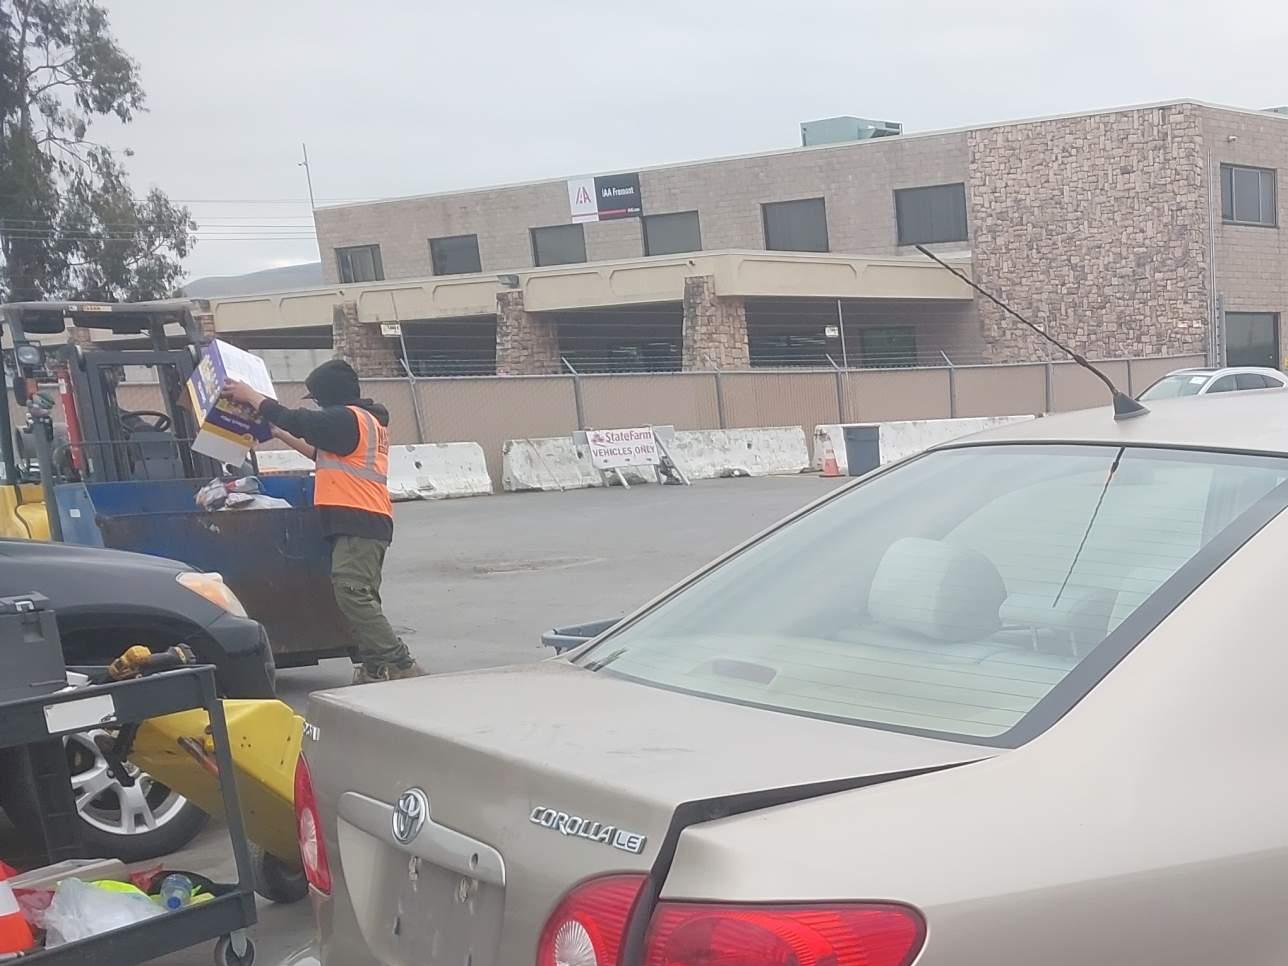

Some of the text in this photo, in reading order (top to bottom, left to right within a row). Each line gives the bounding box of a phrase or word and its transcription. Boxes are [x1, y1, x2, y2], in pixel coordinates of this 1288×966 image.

[602, 187, 613, 198] IAA
[592, 445, 656, 457] VEHICLES ONLY
[529, 806, 642, 852] COROLLA LE
